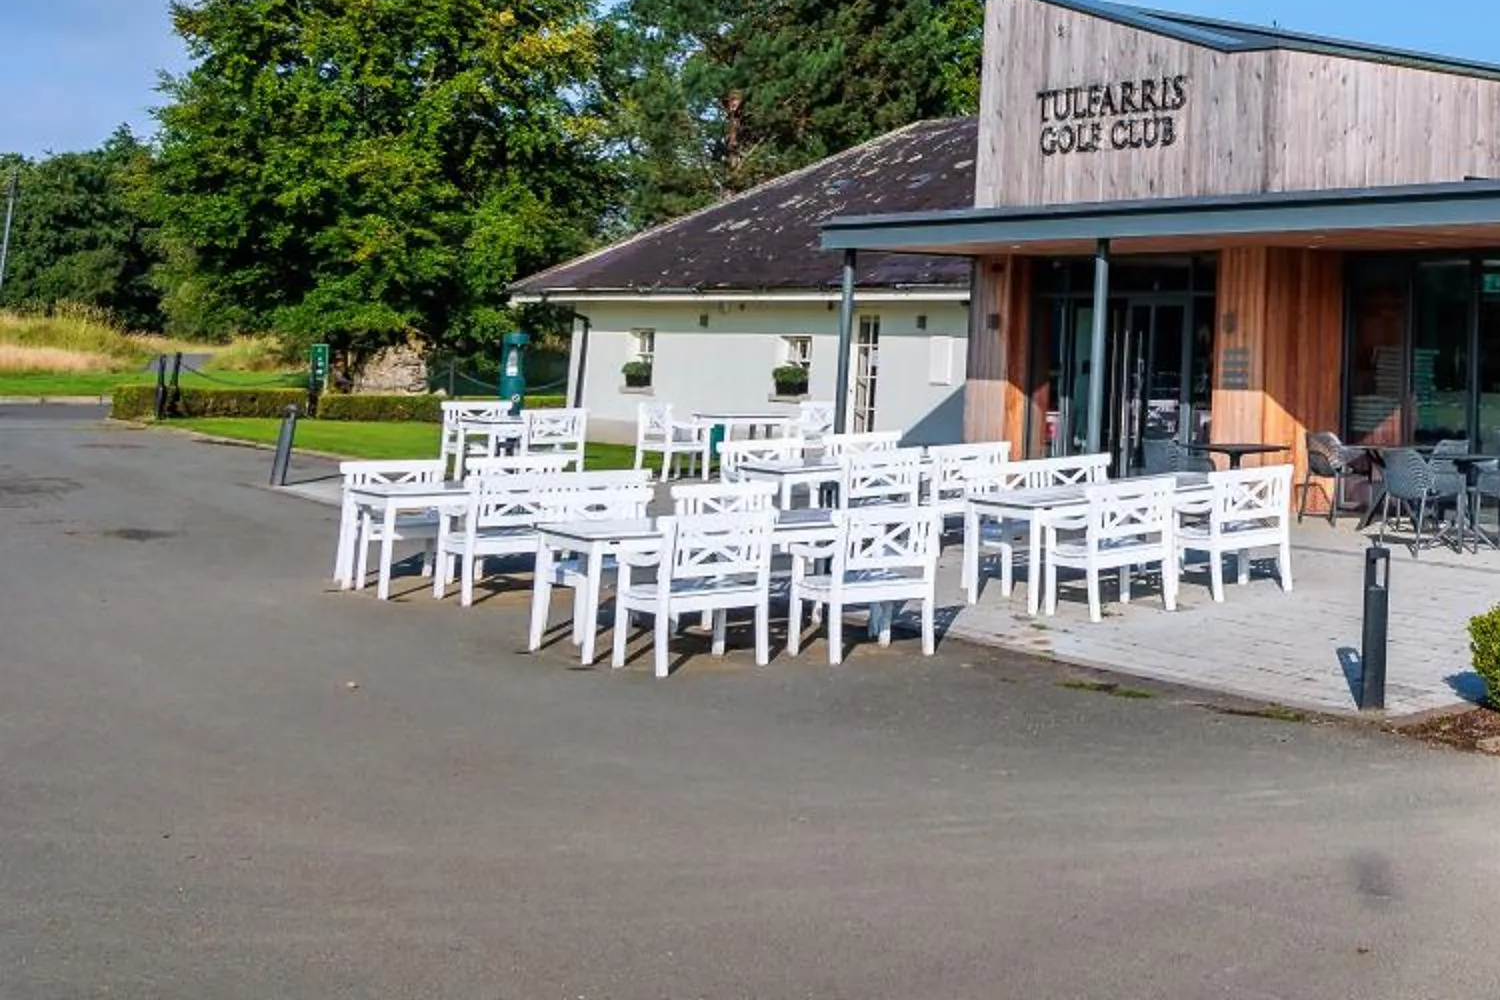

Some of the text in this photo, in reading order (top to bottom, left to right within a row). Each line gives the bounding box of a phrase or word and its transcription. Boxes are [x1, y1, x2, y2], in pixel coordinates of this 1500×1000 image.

[1036, 75, 1187, 122] TULFARRIS
[1040, 116, 1176, 156] GOLF CLUB
